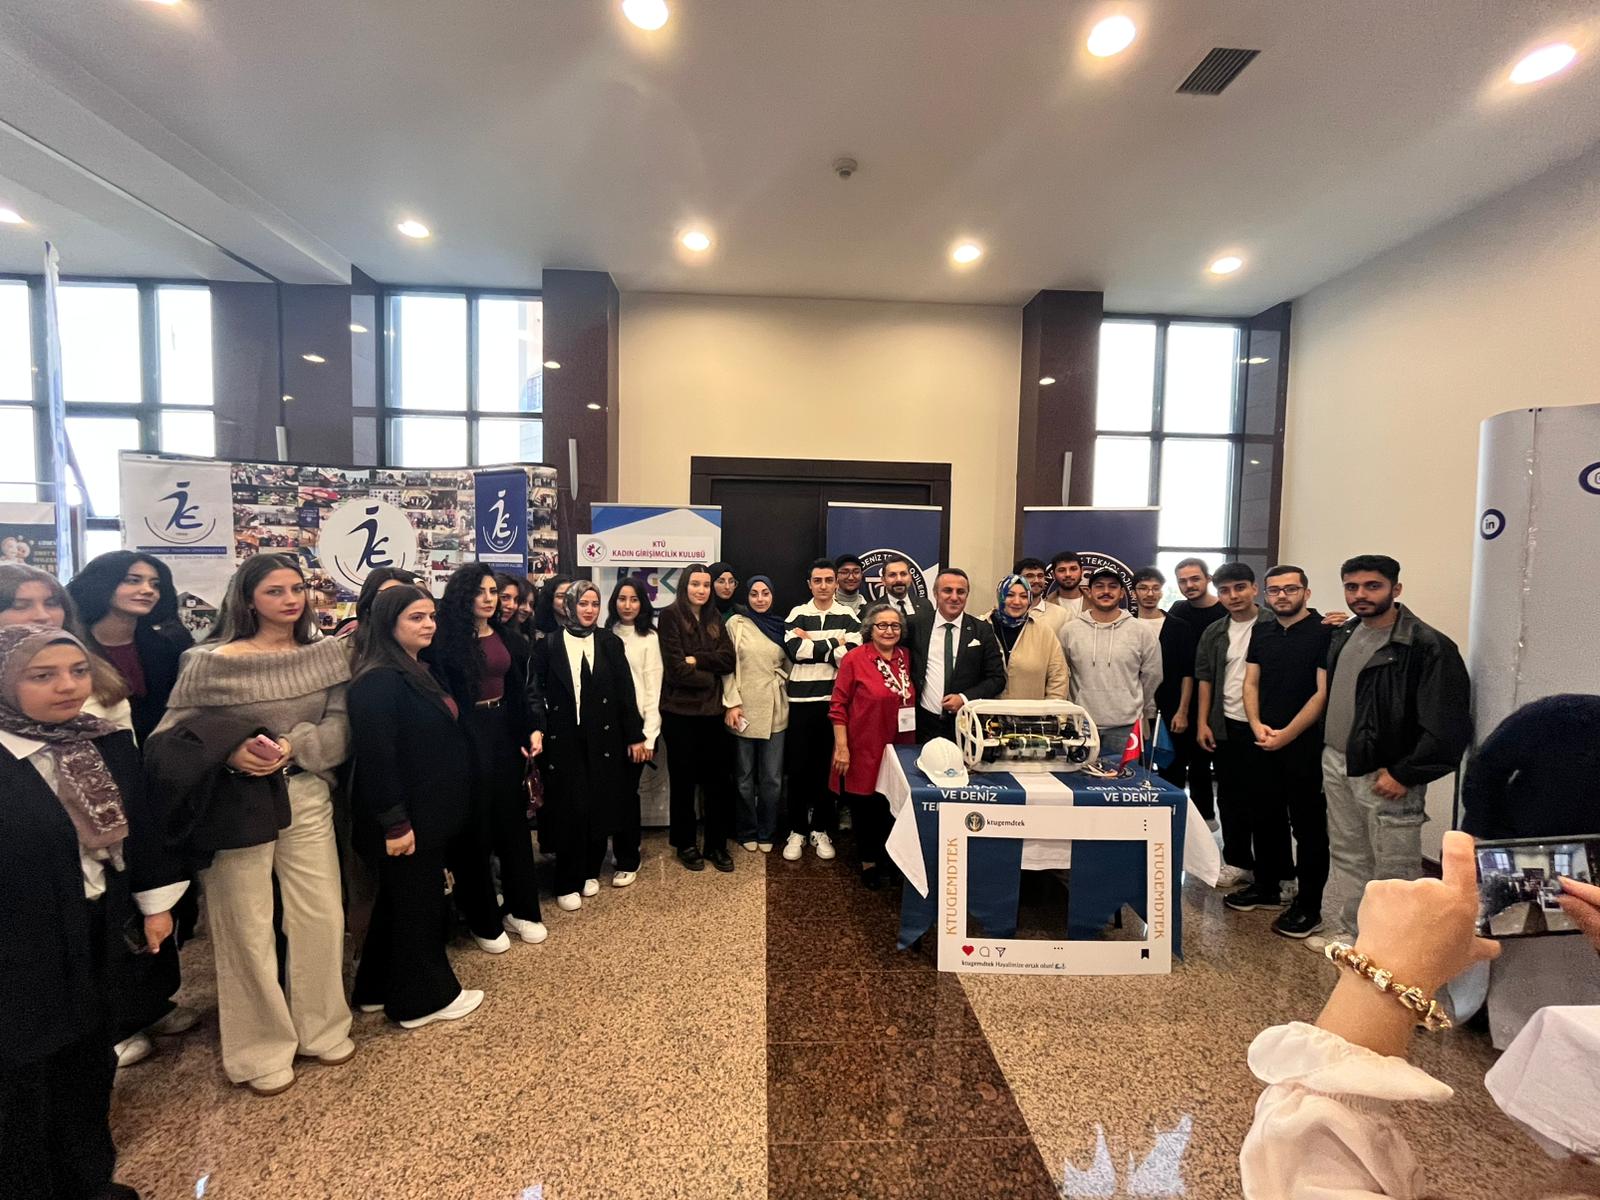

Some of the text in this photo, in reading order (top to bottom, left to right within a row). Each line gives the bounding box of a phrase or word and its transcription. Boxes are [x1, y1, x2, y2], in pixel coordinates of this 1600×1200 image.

[652, 540, 666, 548] KTÜ
[635, 550, 678, 559] GİRİŞİMCİLİK
[941, 789, 998, 802] VE DENİZ
[1103, 791, 1159, 803] VE DENİZ
[987, 819, 1025, 827] ktugemdtek
[945, 838, 958, 935] KTUGEMDTEK
[1153, 842, 1165, 939] KTUGEMDTEK
